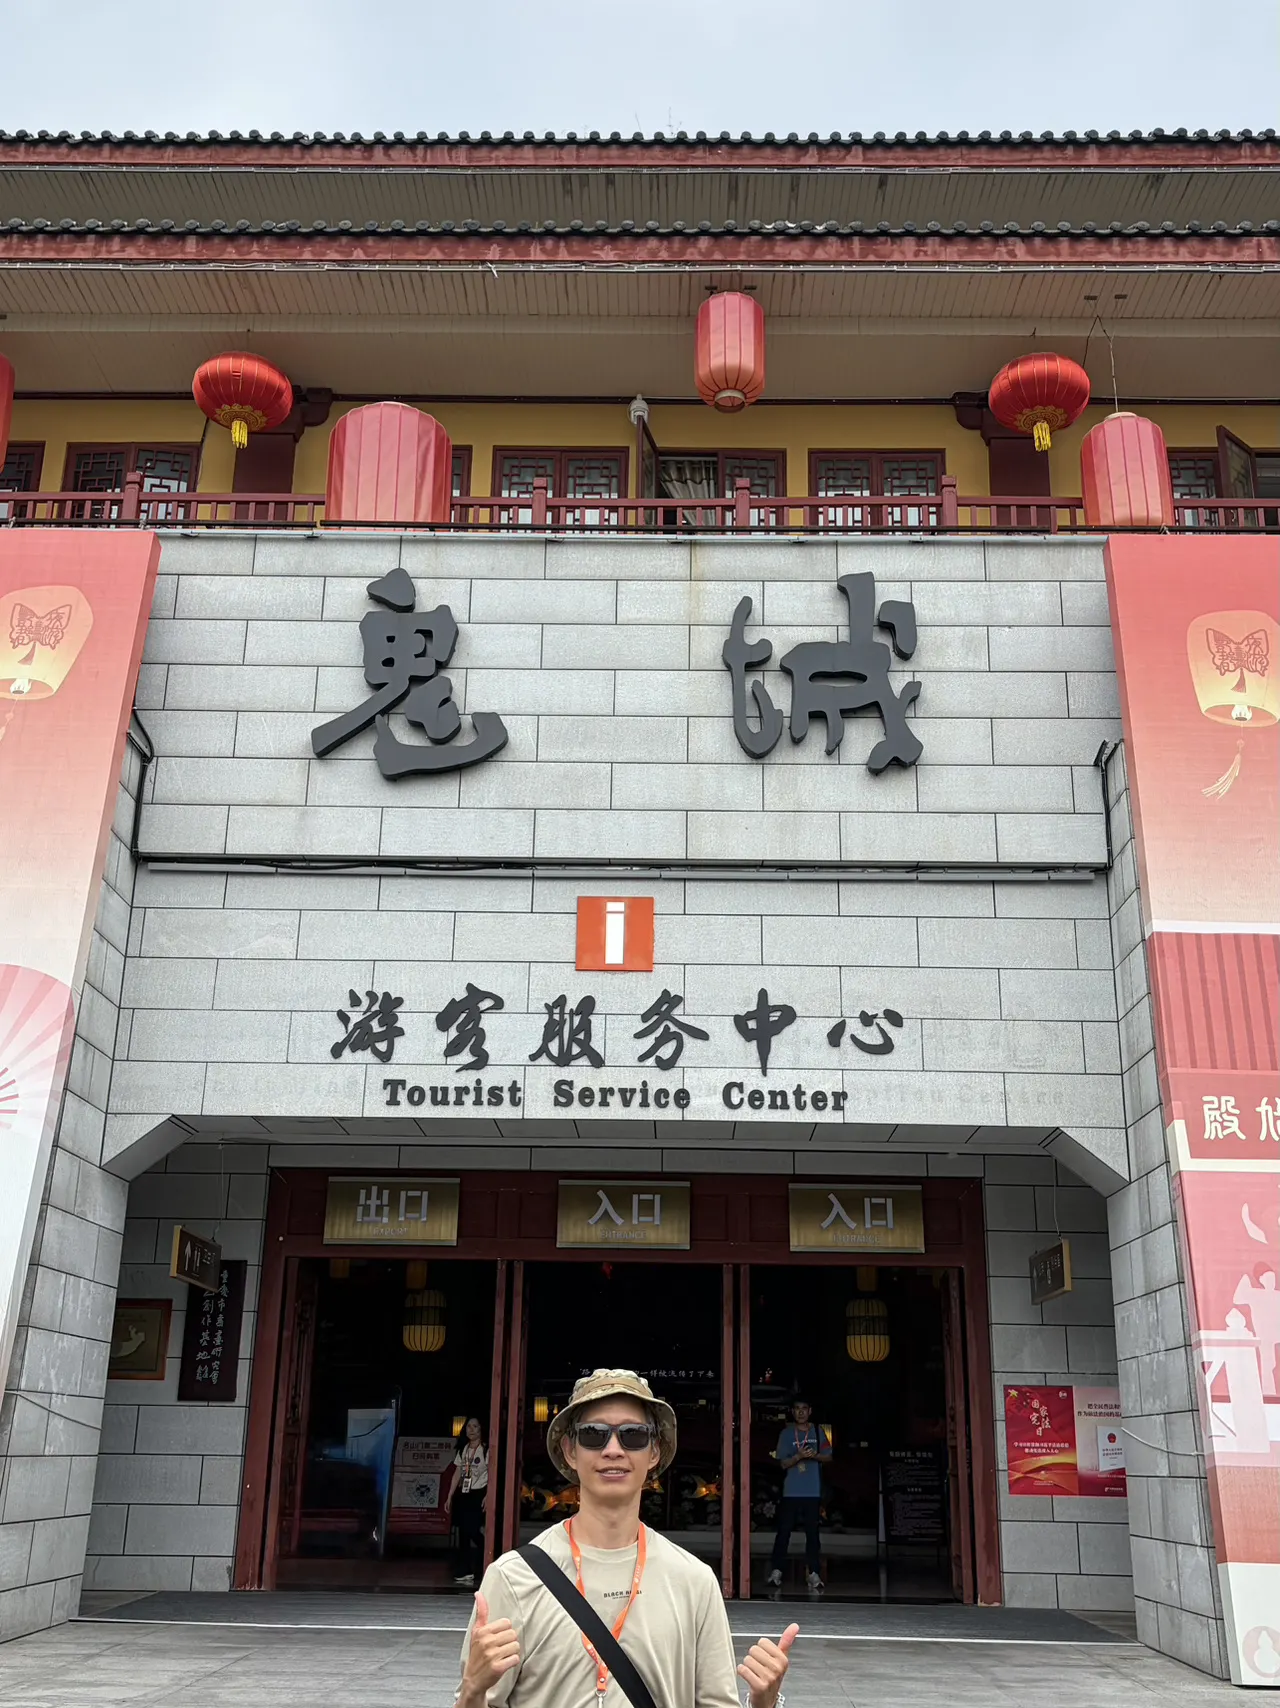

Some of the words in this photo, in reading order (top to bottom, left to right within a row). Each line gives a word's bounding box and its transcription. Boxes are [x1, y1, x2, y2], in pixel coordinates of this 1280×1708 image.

[331, 982, 904, 1076] 游客服务中心
[383, 1078, 522, 1107] Tourist
[554, 1079, 691, 1109] Service
[722, 1081, 849, 1112] Center
[356, 1185, 429, 1223] 出口
[588, 1189, 661, 1226] 入口
[820, 1192, 894, 1230] 入口
[600, 1229, 647, 1240] ENTRANCE
